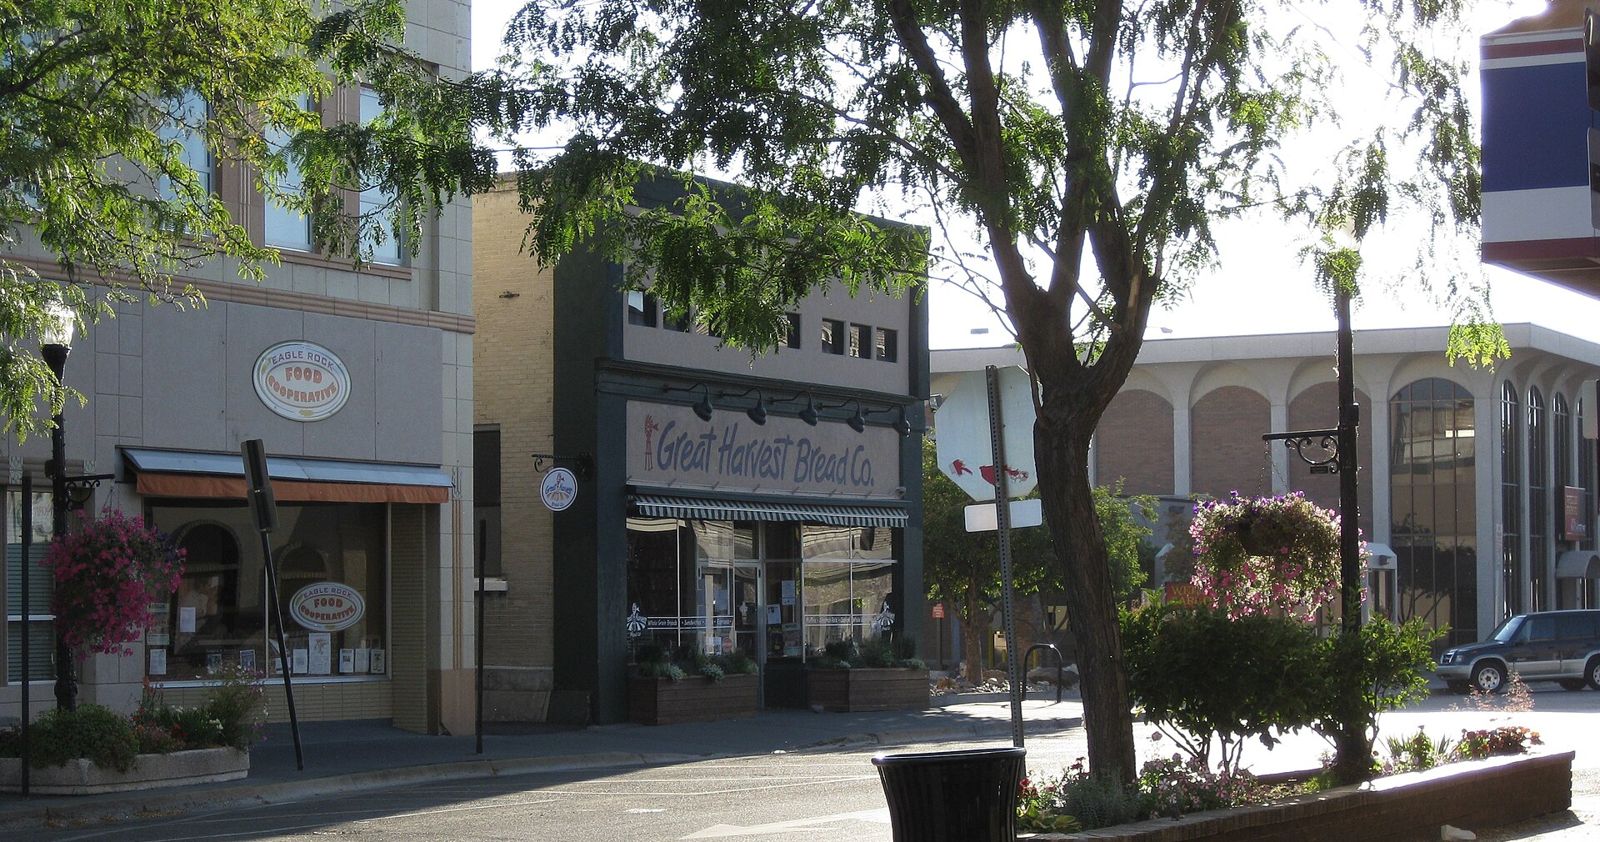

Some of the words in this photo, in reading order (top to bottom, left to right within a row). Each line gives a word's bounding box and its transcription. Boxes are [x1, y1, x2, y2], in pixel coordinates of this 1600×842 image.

[272, 351, 303, 365] EAGLE
[307, 352, 334, 370] ROCK
[285, 367, 322, 384] FOOD
[268, 375, 337, 403] COOPERATIVE
[657, 420, 716, 474] Great
[718, 423, 793, 480] Harvest
[794, 438, 848, 485] Bread
[851, 445, 874, 487] Co.
[304, 588, 329, 598] EAGLE
[331, 588, 352, 597] ROCK
[314, 598, 343, 608] FOOD
[301, 605, 355, 620] COOPERATIVE
